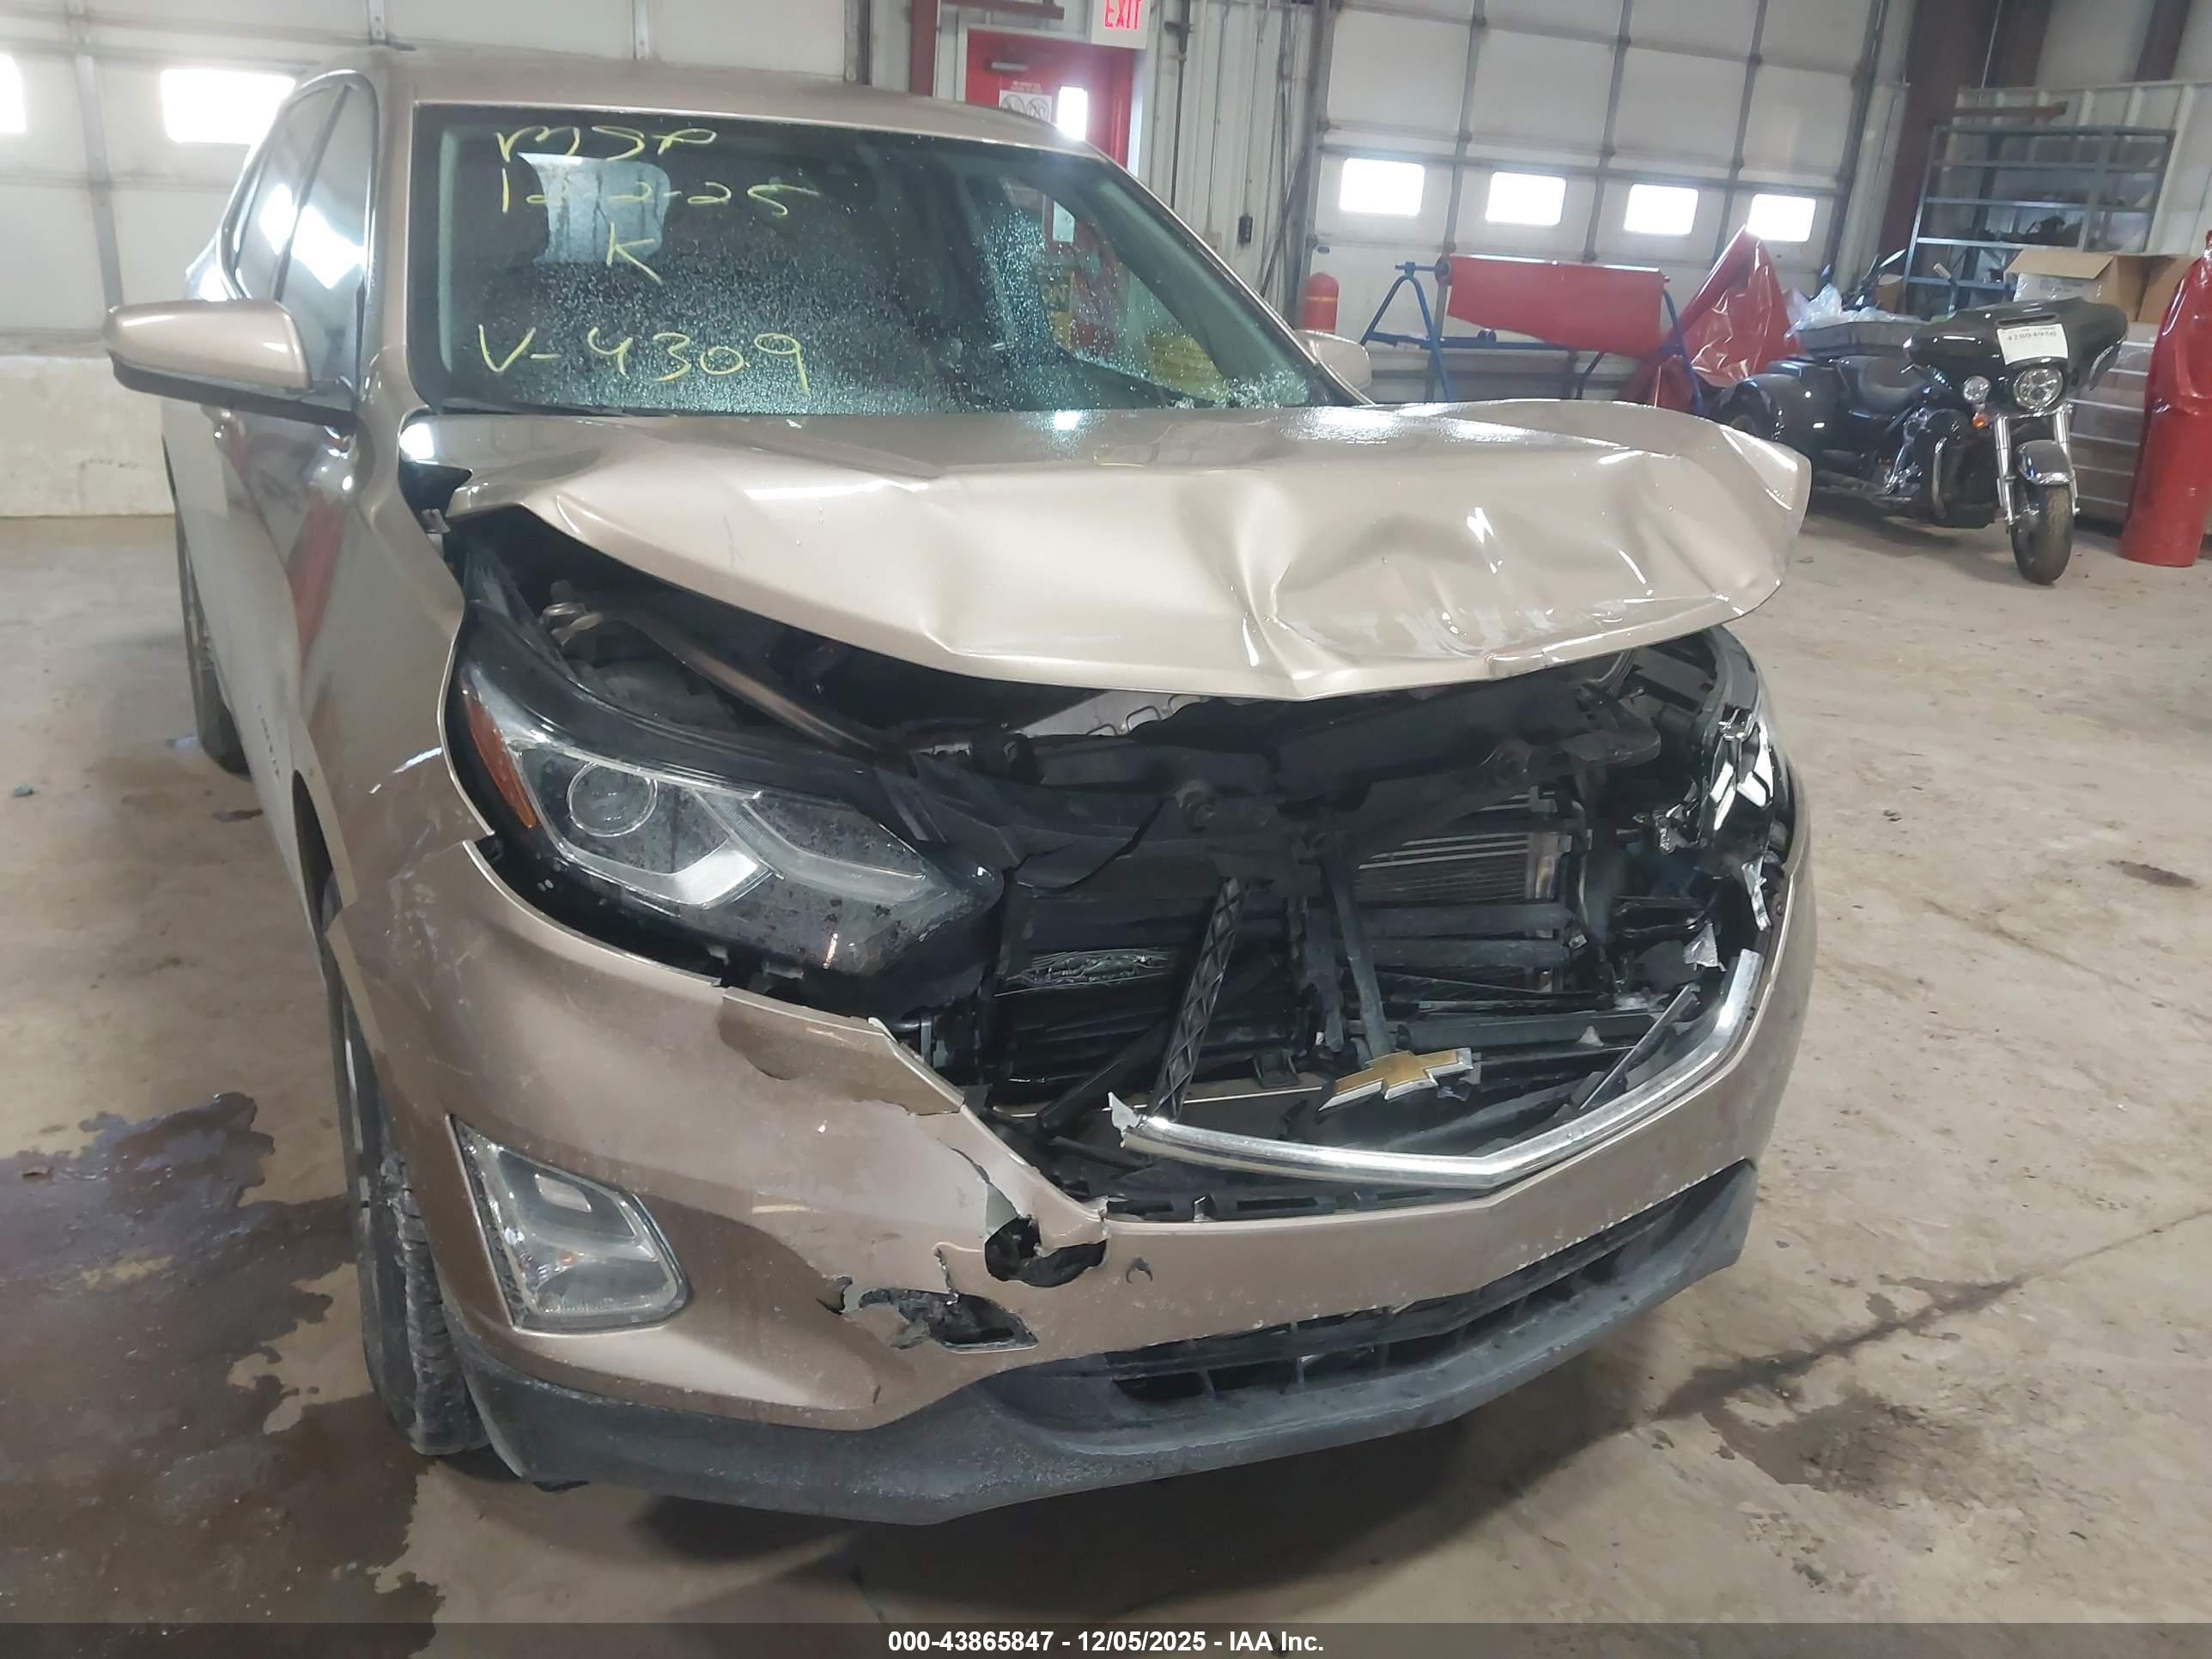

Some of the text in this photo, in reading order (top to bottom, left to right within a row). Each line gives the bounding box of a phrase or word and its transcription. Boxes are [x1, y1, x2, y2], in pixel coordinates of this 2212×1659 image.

[1104, 0, 1139, 29] EXIT
[605, 222, 662, 284] K
[478, 324, 809, 396] V-4309
